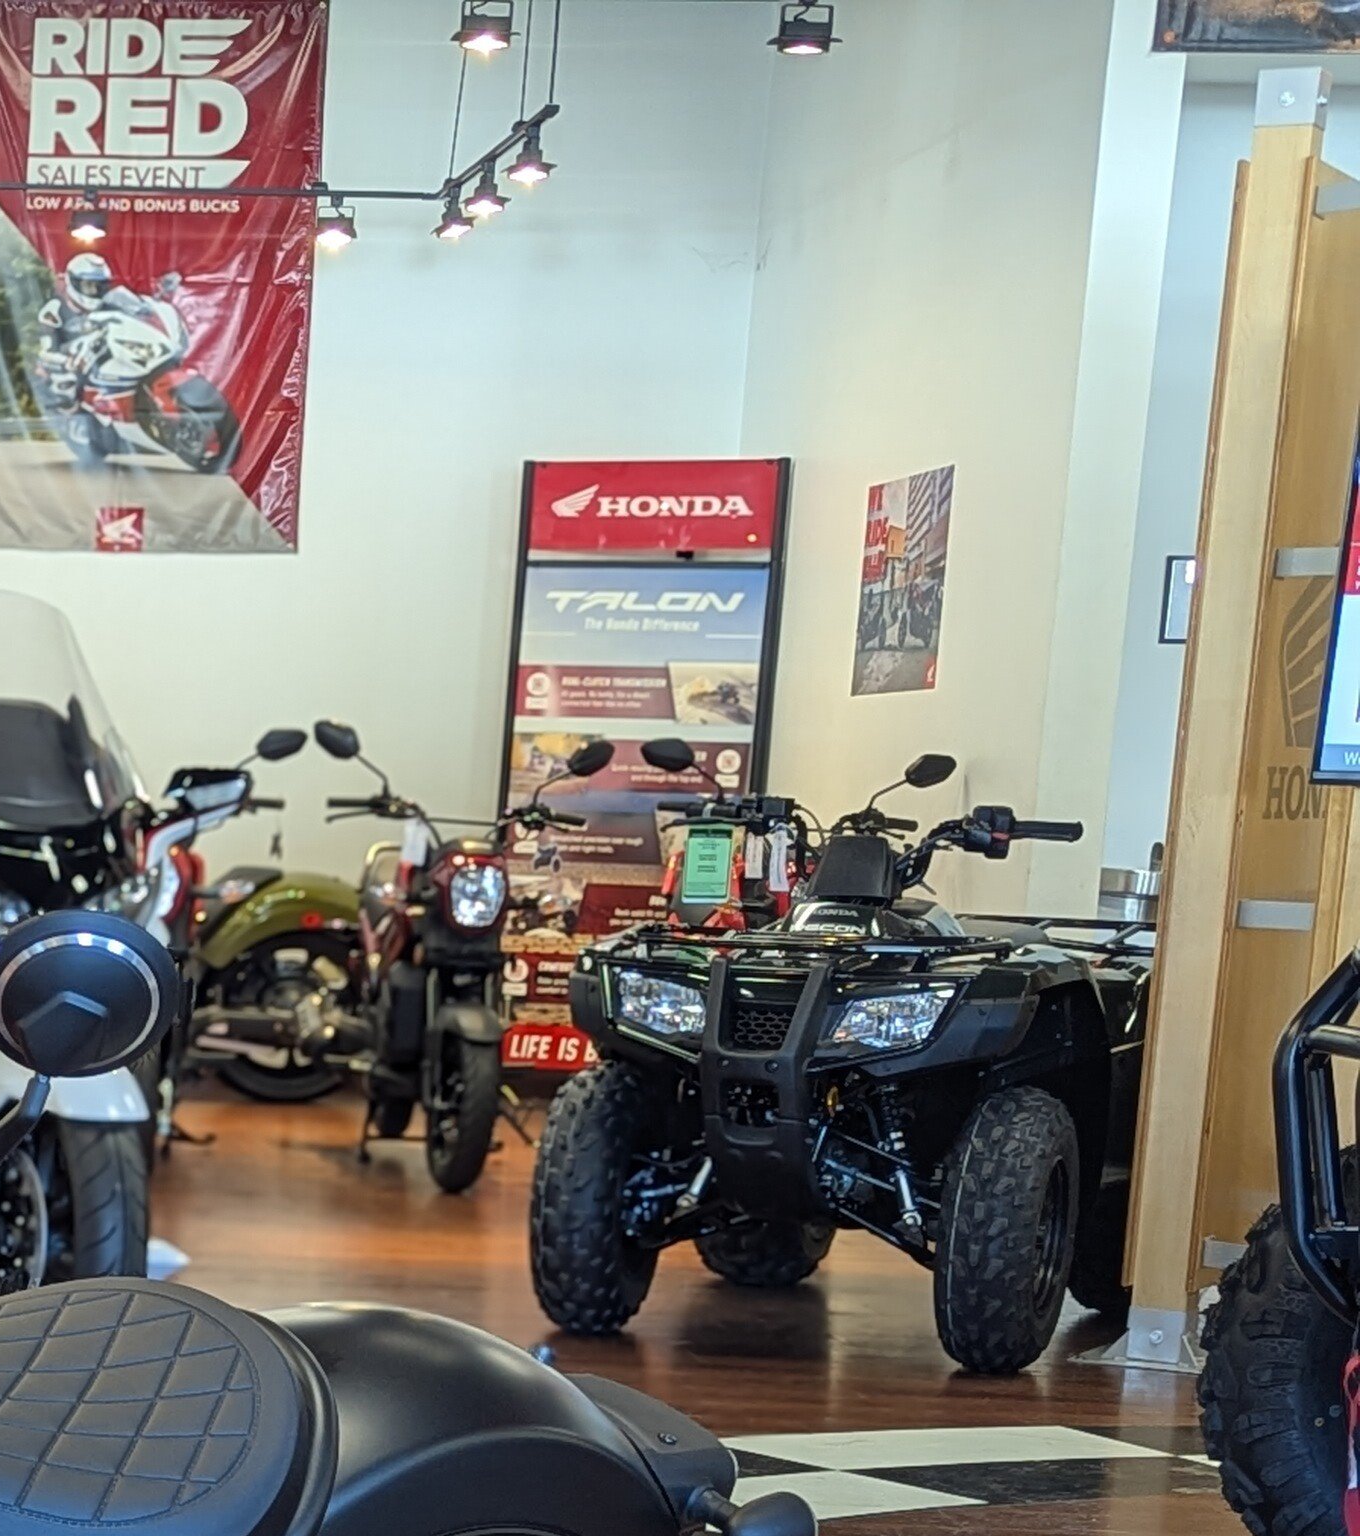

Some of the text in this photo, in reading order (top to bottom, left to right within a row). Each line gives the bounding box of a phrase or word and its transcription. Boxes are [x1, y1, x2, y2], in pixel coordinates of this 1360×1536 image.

[33, 17, 254, 76] RIDE
[26, 77, 250, 157] RED
[37, 164, 207, 189] SALES EVENT
[26, 197, 60, 210] LOW
[133, 198, 186, 213] BONUS
[189, 199, 241, 214] BUCKS
[596, 495, 753, 518] HONDA
[546, 590, 746, 614] TALON
[1262, 765, 1327, 821] HON
[509, 1034, 553, 1060] LIFE
[556, 1036, 580, 1062] IS
